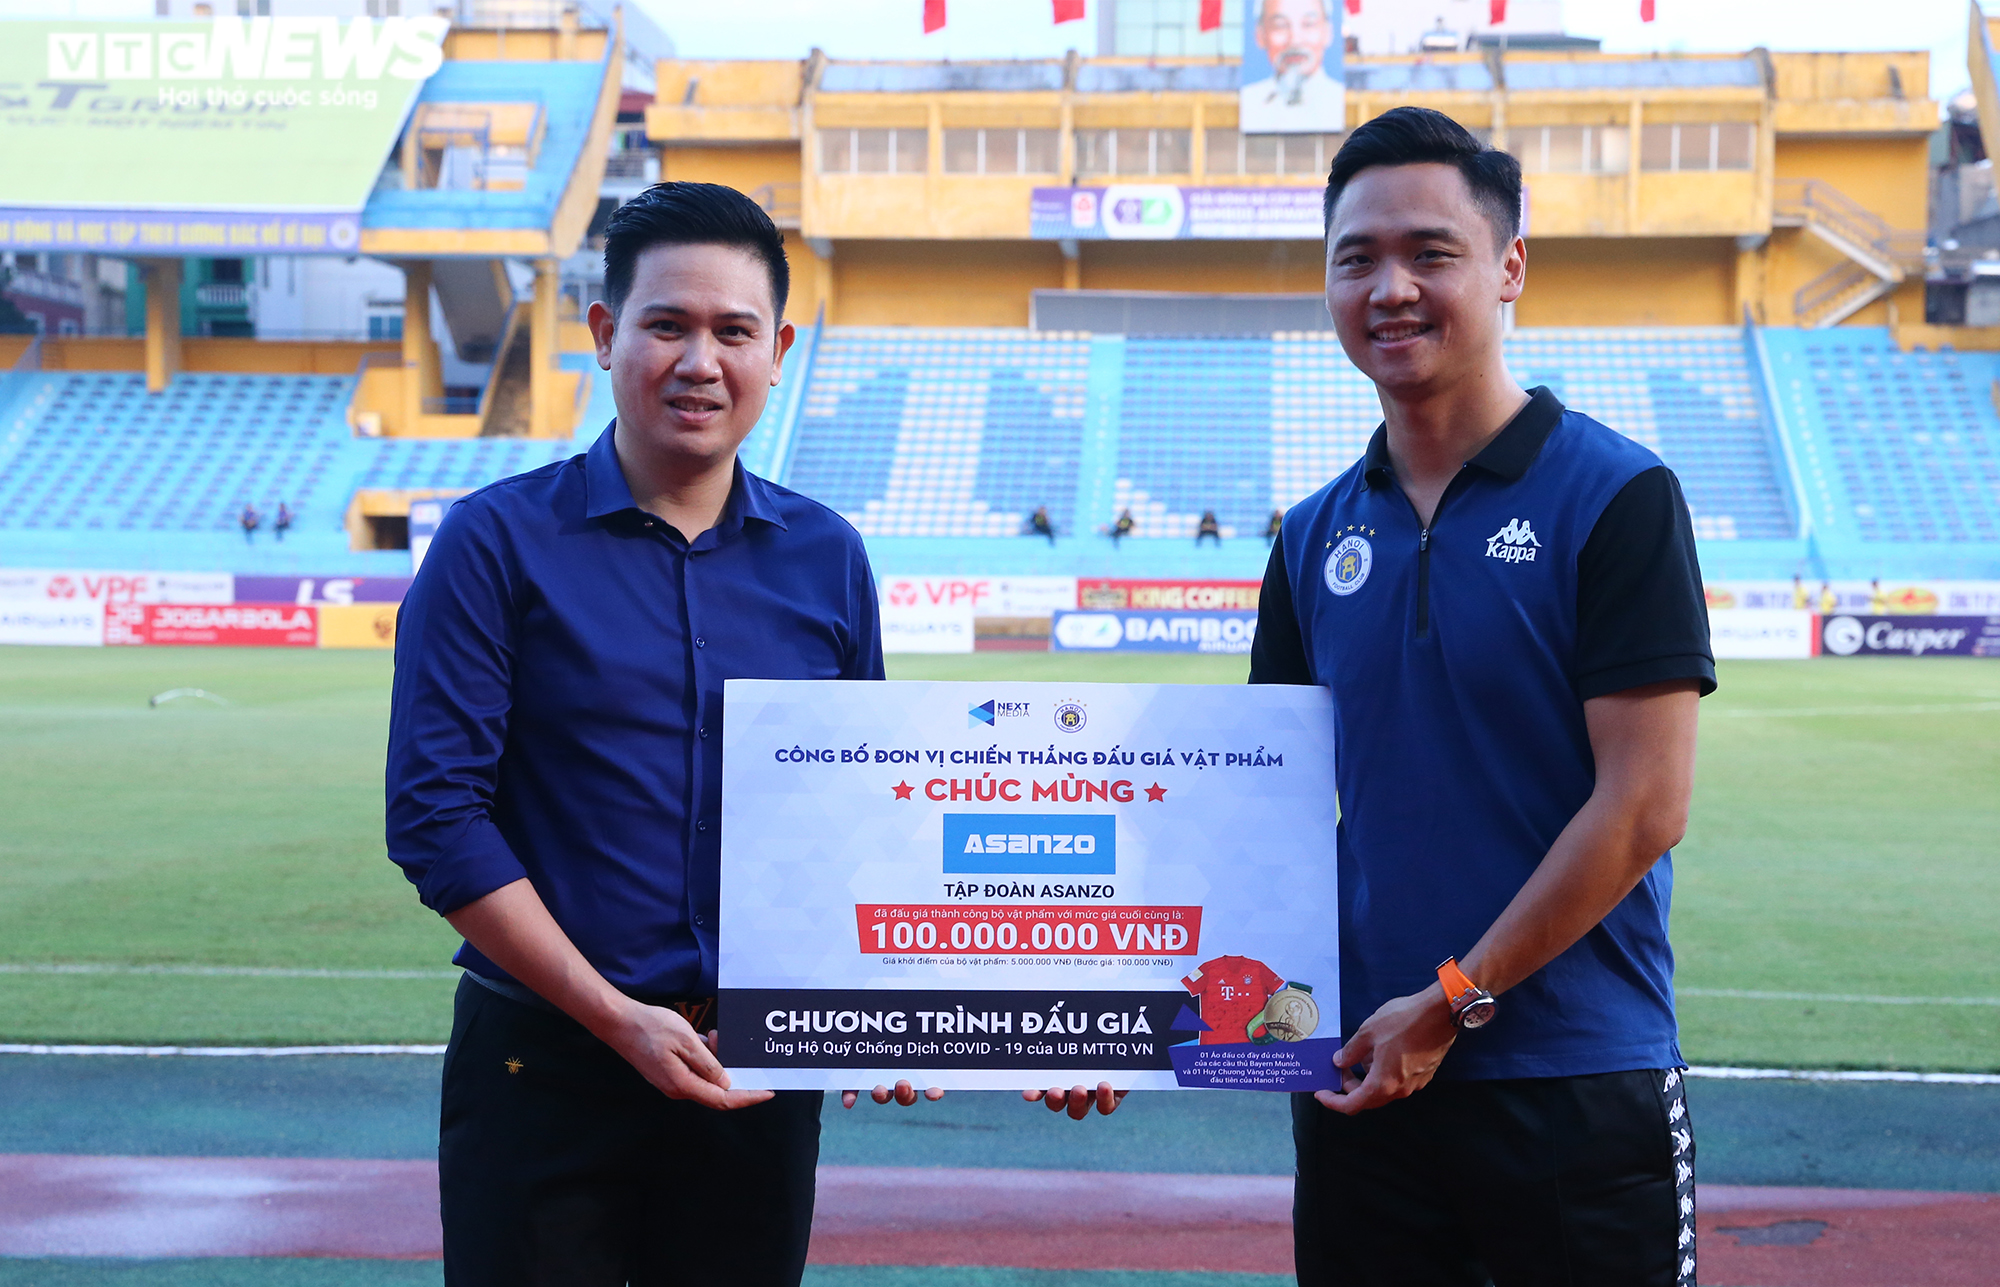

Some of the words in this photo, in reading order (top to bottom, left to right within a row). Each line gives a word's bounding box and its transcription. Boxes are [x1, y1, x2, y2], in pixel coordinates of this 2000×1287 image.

[1334, 539, 1365, 559] HANOI
[1485, 541, 1536, 563] Kappa
[153, 606, 313, 631] JOGARBOLA
[1865, 621, 1967, 655] Casper
[997, 702, 1030, 711] NEXT
[774, 744, 836, 763] CÔNG
[841, 742, 870, 763] BỐ
[874, 749, 919, 764] ĐƠN
[925, 750, 945, 768] VỊ
[949, 743, 1012, 765] CHIẾN
[1017, 744, 1088, 765] THẮNG
[1092, 744, 1135, 766] ĐẤU
[1140, 748, 1175, 766] GIÁ
[1180, 748, 1220, 770] VẬT
[1225, 745, 1283, 767] PHẨM
[924, 771, 1022, 802] CHÚC
[1031, 772, 1135, 803] MỪNG
[943, 880, 979, 900] TẬP
[983, 881, 1035, 898] ĐOÀN
[1040, 884, 1115, 899] ASANZO
[874, 908, 888, 918] đã
[890, 907, 910, 918] đấu
[912, 908, 928, 920] giá
[931, 909, 960, 918] thành
[962, 909, 989, 920] công
[991, 909, 1005, 920] bộ
[1007, 909, 1022, 920] vật
[1057, 909, 1072, 919] với
[1075, 909, 1099, 919] mức
[1101, 910, 1116, 921] giá
[1119, 909, 1142, 919] cuối
[1144, 910, 1170, 921] cùng
[1172, 910, 1185, 919] là:
[871, 921, 1099, 950] 100.000.000
[1108, 923, 1189, 951] VNĐ
[882, 957, 896, 965] Giá
[940, 957, 955, 965] của
[957, 957, 967, 966] bộ
[969, 957, 981, 966] vật
[1011, 958, 1051, 966] 5.000.000
[1053, 958, 1071, 966] VNĐ
[1074, 957, 1098, 967] (Bước
[1100, 958, 1115, 967] giá:
[1117, 958, 1150, 966] 100.000
[1152, 958, 1174, 967] VNĐ)
[765, 1010, 908, 1034] CHƯƠNG
[915, 1005, 1012, 1034] TRÌNH
[1021, 1000, 1088, 1034] ĐẤU
[1096, 1005, 1153, 1034] GIÁ
[764, 1037, 794, 1056] Ủng
[798, 1040, 819, 1056] Hộ
[823, 1039, 851, 1057] Quỹ
[855, 1039, 903, 1057] Chống
[907, 1041, 939, 1057] Dịch
[943, 1042, 991, 1055] COVID
[1004, 1042, 1022, 1055] 19
[1026, 1040, 1053, 1055] của
[1057, 1042, 1079, 1055] UB
[1082, 1042, 1128, 1057] MTTQ
[1132, 1042, 1154, 1055] VN
[1236, 1051, 1246, 1059] có
[1202, 1068, 1217, 1076] Huy
[1246, 1068, 1265, 1077] Vàng
[1249, 1060, 1274, 1068] Bayern
[1253, 1076, 1274, 1084] Hanoi
[1275, 1076, 1286, 1084] FC
